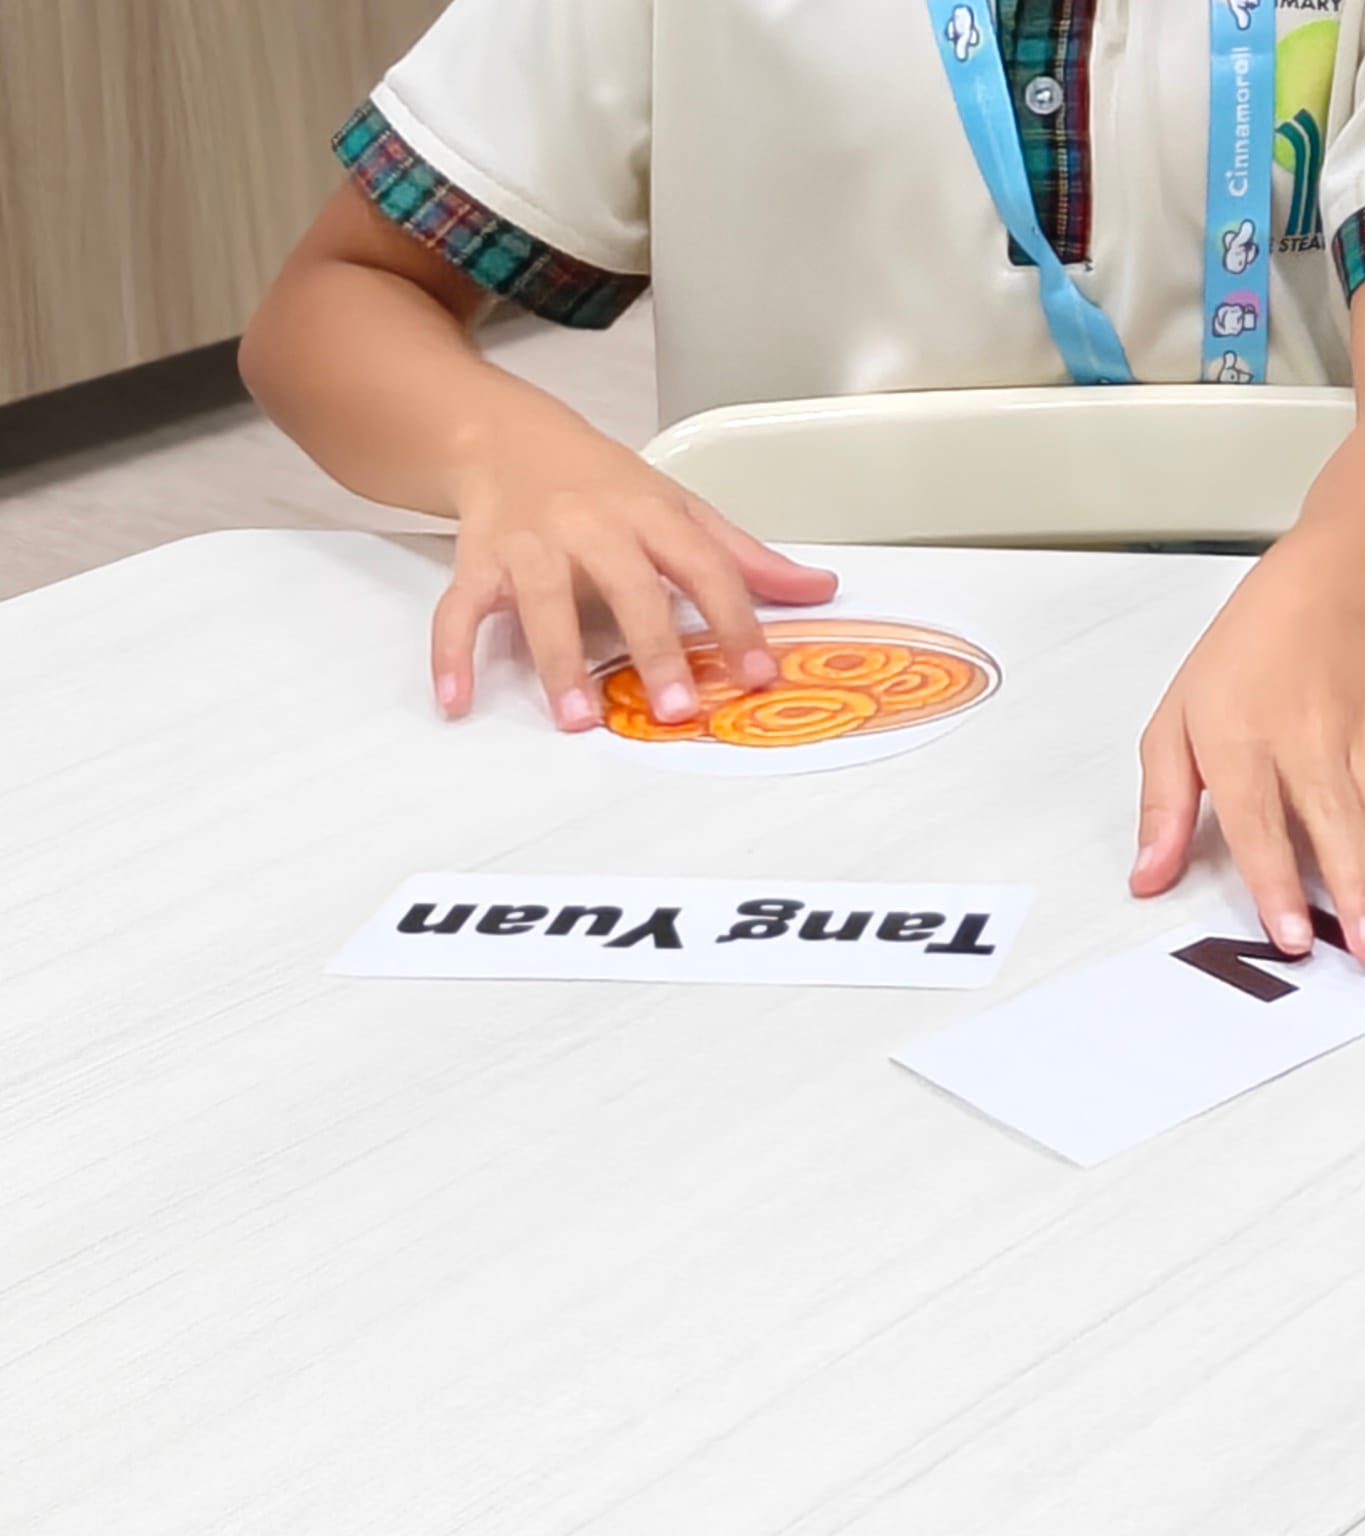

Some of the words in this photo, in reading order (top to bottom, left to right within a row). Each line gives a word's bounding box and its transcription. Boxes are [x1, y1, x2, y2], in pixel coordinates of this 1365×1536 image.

[1225, 46, 1251, 197] Cinnamoroll
[395, 902, 684, 949] Yuan
[715, 898, 996, 955] Tang
